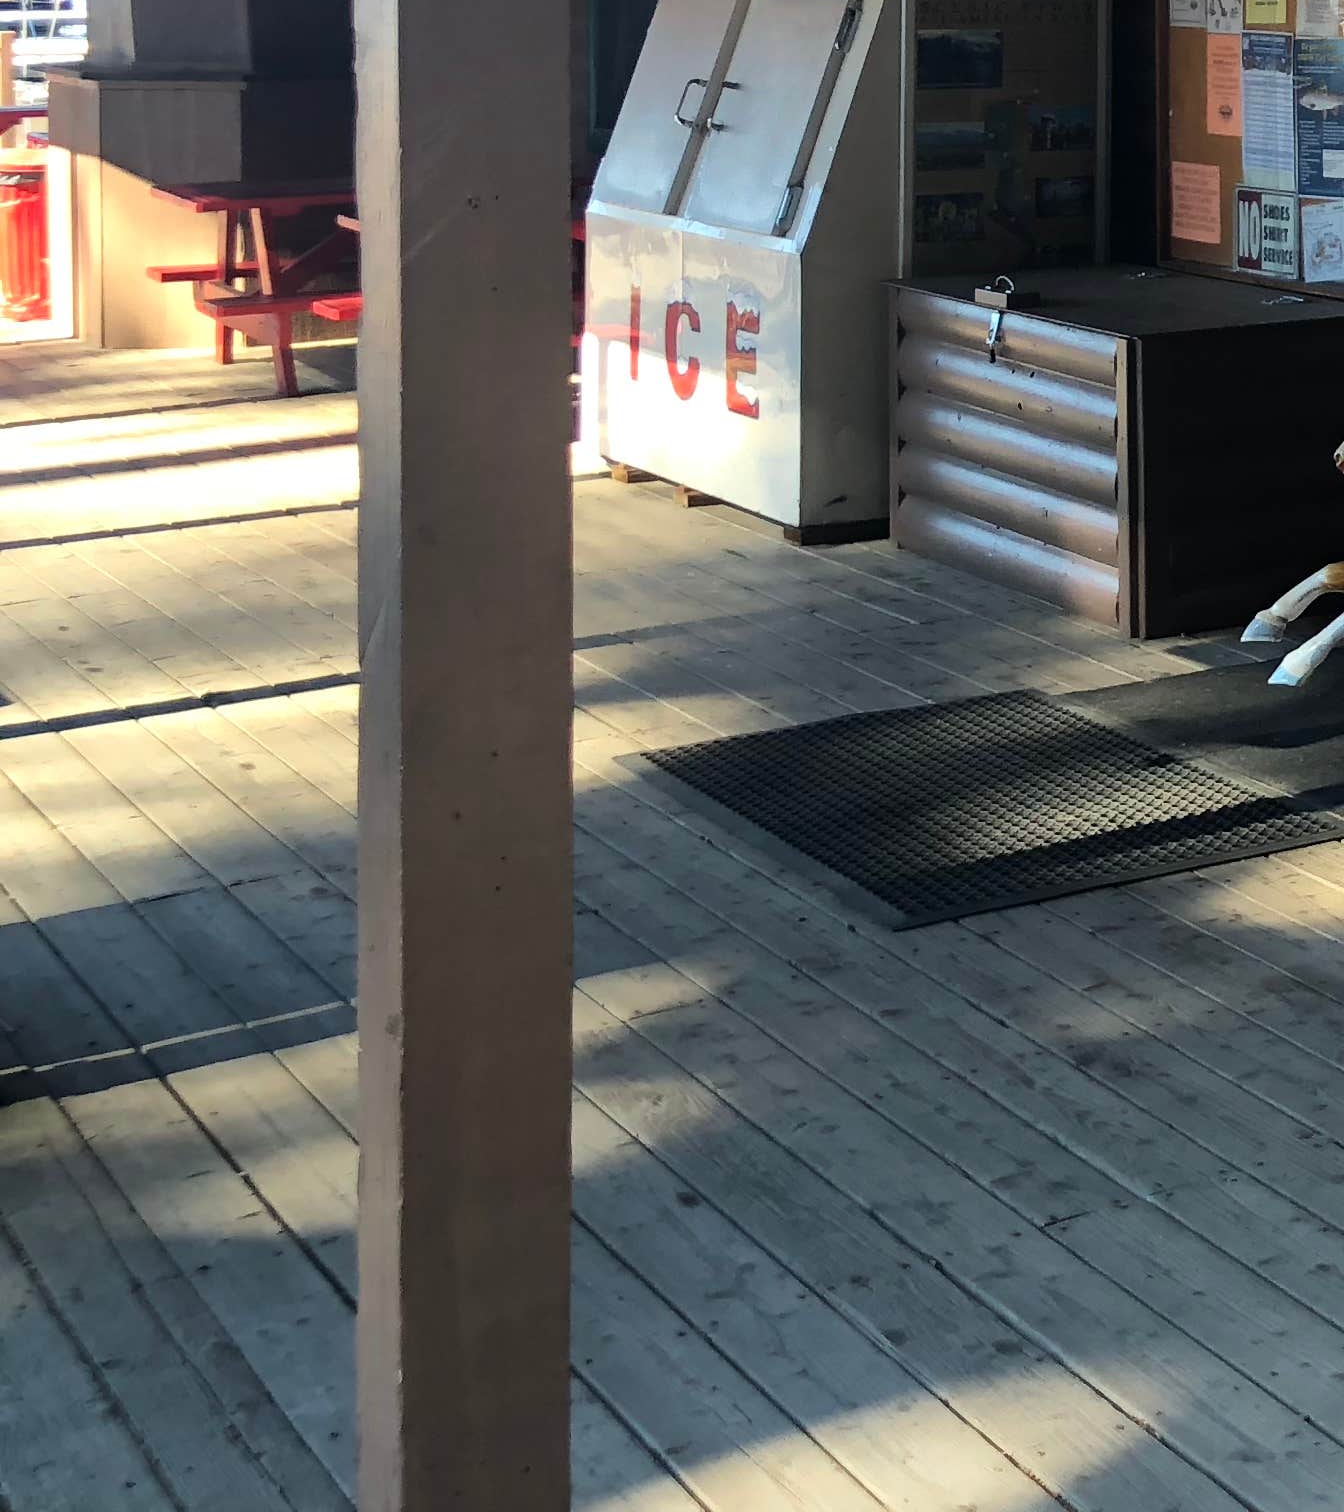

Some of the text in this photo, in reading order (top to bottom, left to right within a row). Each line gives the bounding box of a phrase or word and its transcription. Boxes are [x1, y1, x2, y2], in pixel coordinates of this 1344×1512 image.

[1239, 200, 1260, 261] NO
[1263, 204, 1290, 221] SHOES
[1263, 225, 1289, 242] SHIRT
[1263, 247, 1293, 265] SERVICE
[630, 271, 761, 420] ICE
